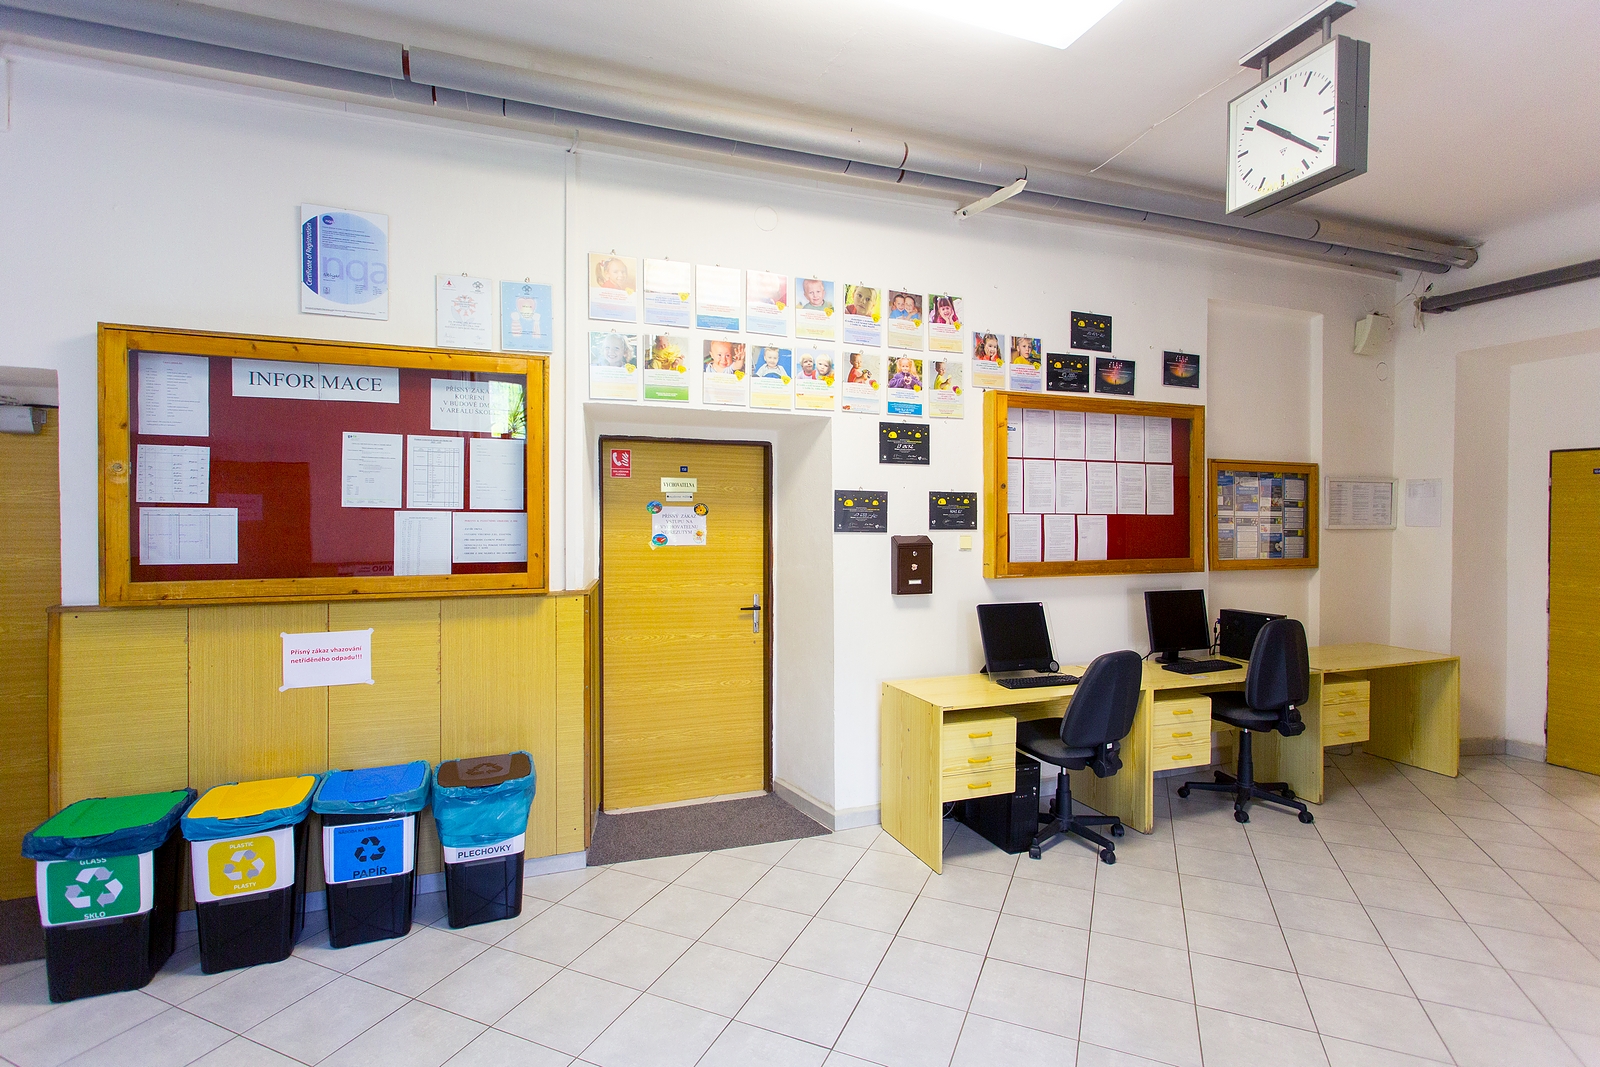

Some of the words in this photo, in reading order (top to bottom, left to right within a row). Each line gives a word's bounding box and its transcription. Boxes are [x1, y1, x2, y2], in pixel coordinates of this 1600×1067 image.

[305, 222, 314, 253] Registration
[305, 260, 313, 286] Certificate
[229, 841, 254, 850] PLASTIC
[457, 844, 512, 859] PLECHOVKY
[79, 857, 107, 866] GLASS
[352, 865, 388, 880] PAPÍR
[233, 881, 257, 890] PLASTY
[84, 911, 106, 920] SKLO
